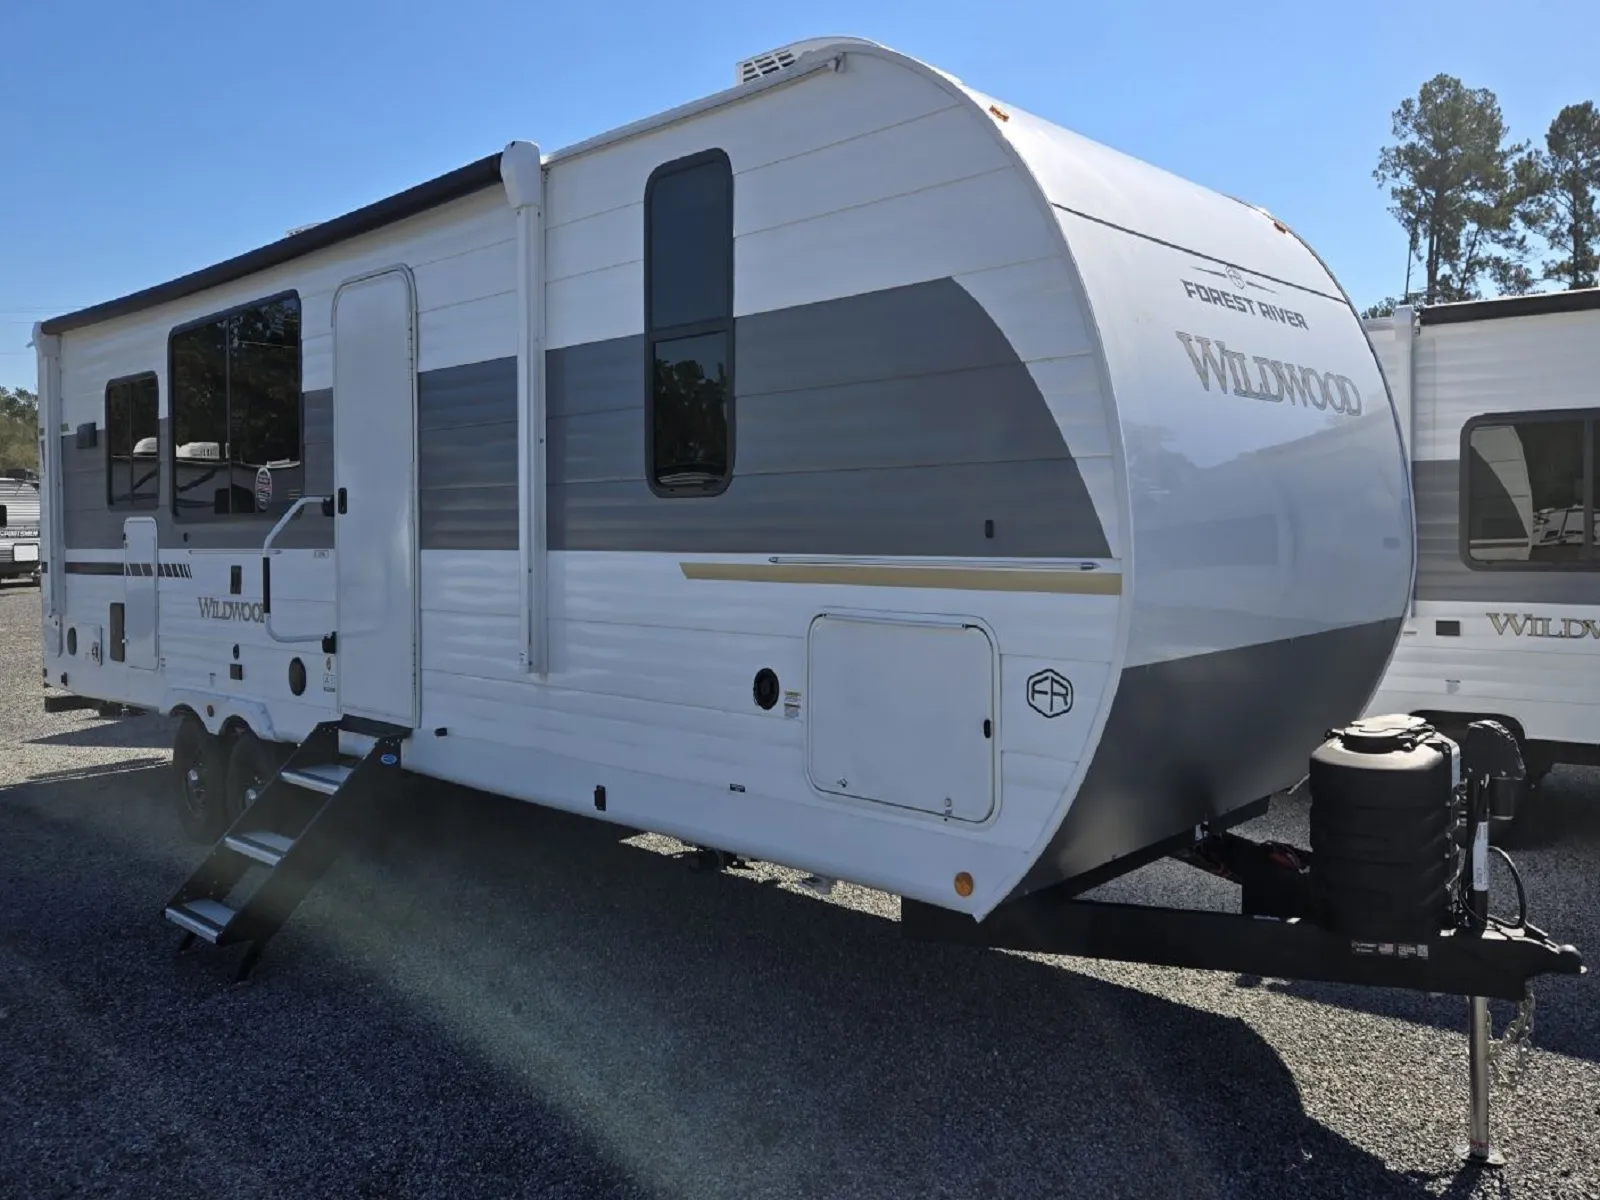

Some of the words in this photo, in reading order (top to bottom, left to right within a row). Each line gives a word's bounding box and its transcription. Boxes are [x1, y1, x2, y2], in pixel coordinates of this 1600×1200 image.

[1180, 279, 1255, 315] FOREST
[1256, 301, 1309, 331] RIVER
[1175, 330, 1362, 417] WILDWOOD
